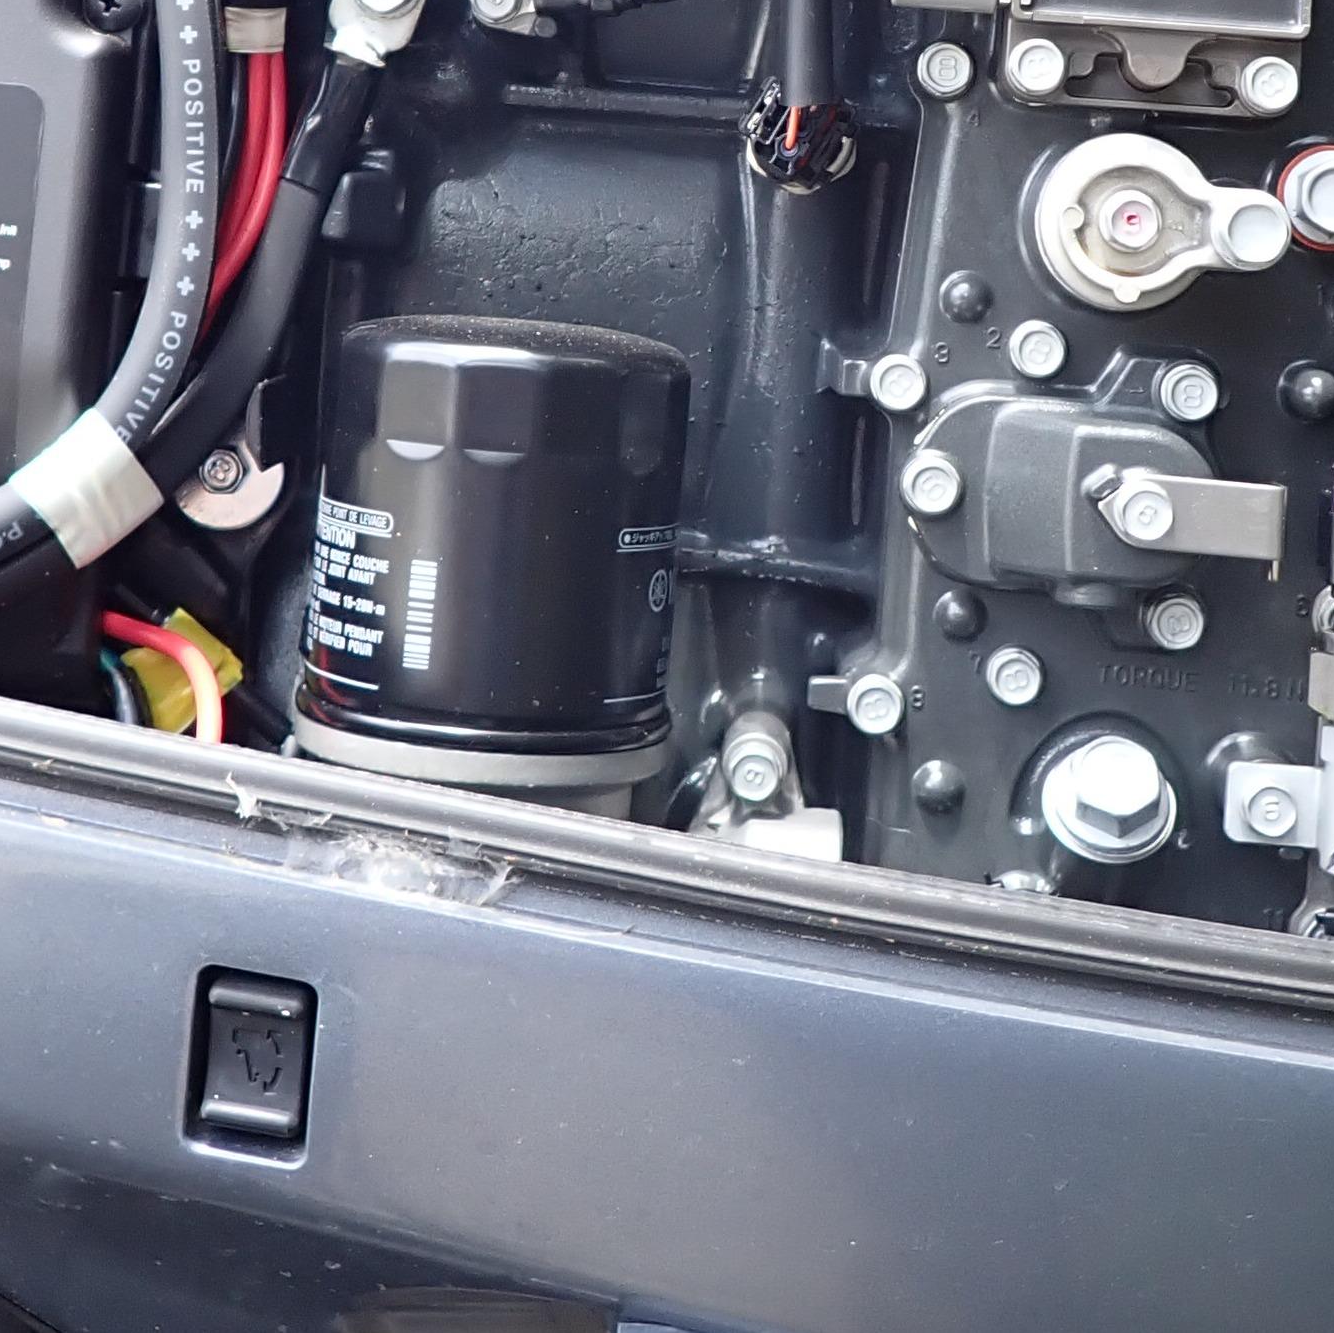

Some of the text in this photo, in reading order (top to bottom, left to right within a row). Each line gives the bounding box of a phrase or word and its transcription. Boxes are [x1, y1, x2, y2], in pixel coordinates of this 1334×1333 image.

[182, 57, 206, 195] POSITIVE
[985, 326, 1003, 348] 2
[114, 311, 188, 444] POSITIVE
[353, 554, 390, 574] COUCHE
[344, 623, 384, 644] PENDANT
[347, 639, 373, 657] POUR
[1096, 660, 1200, 694] TORQUE
